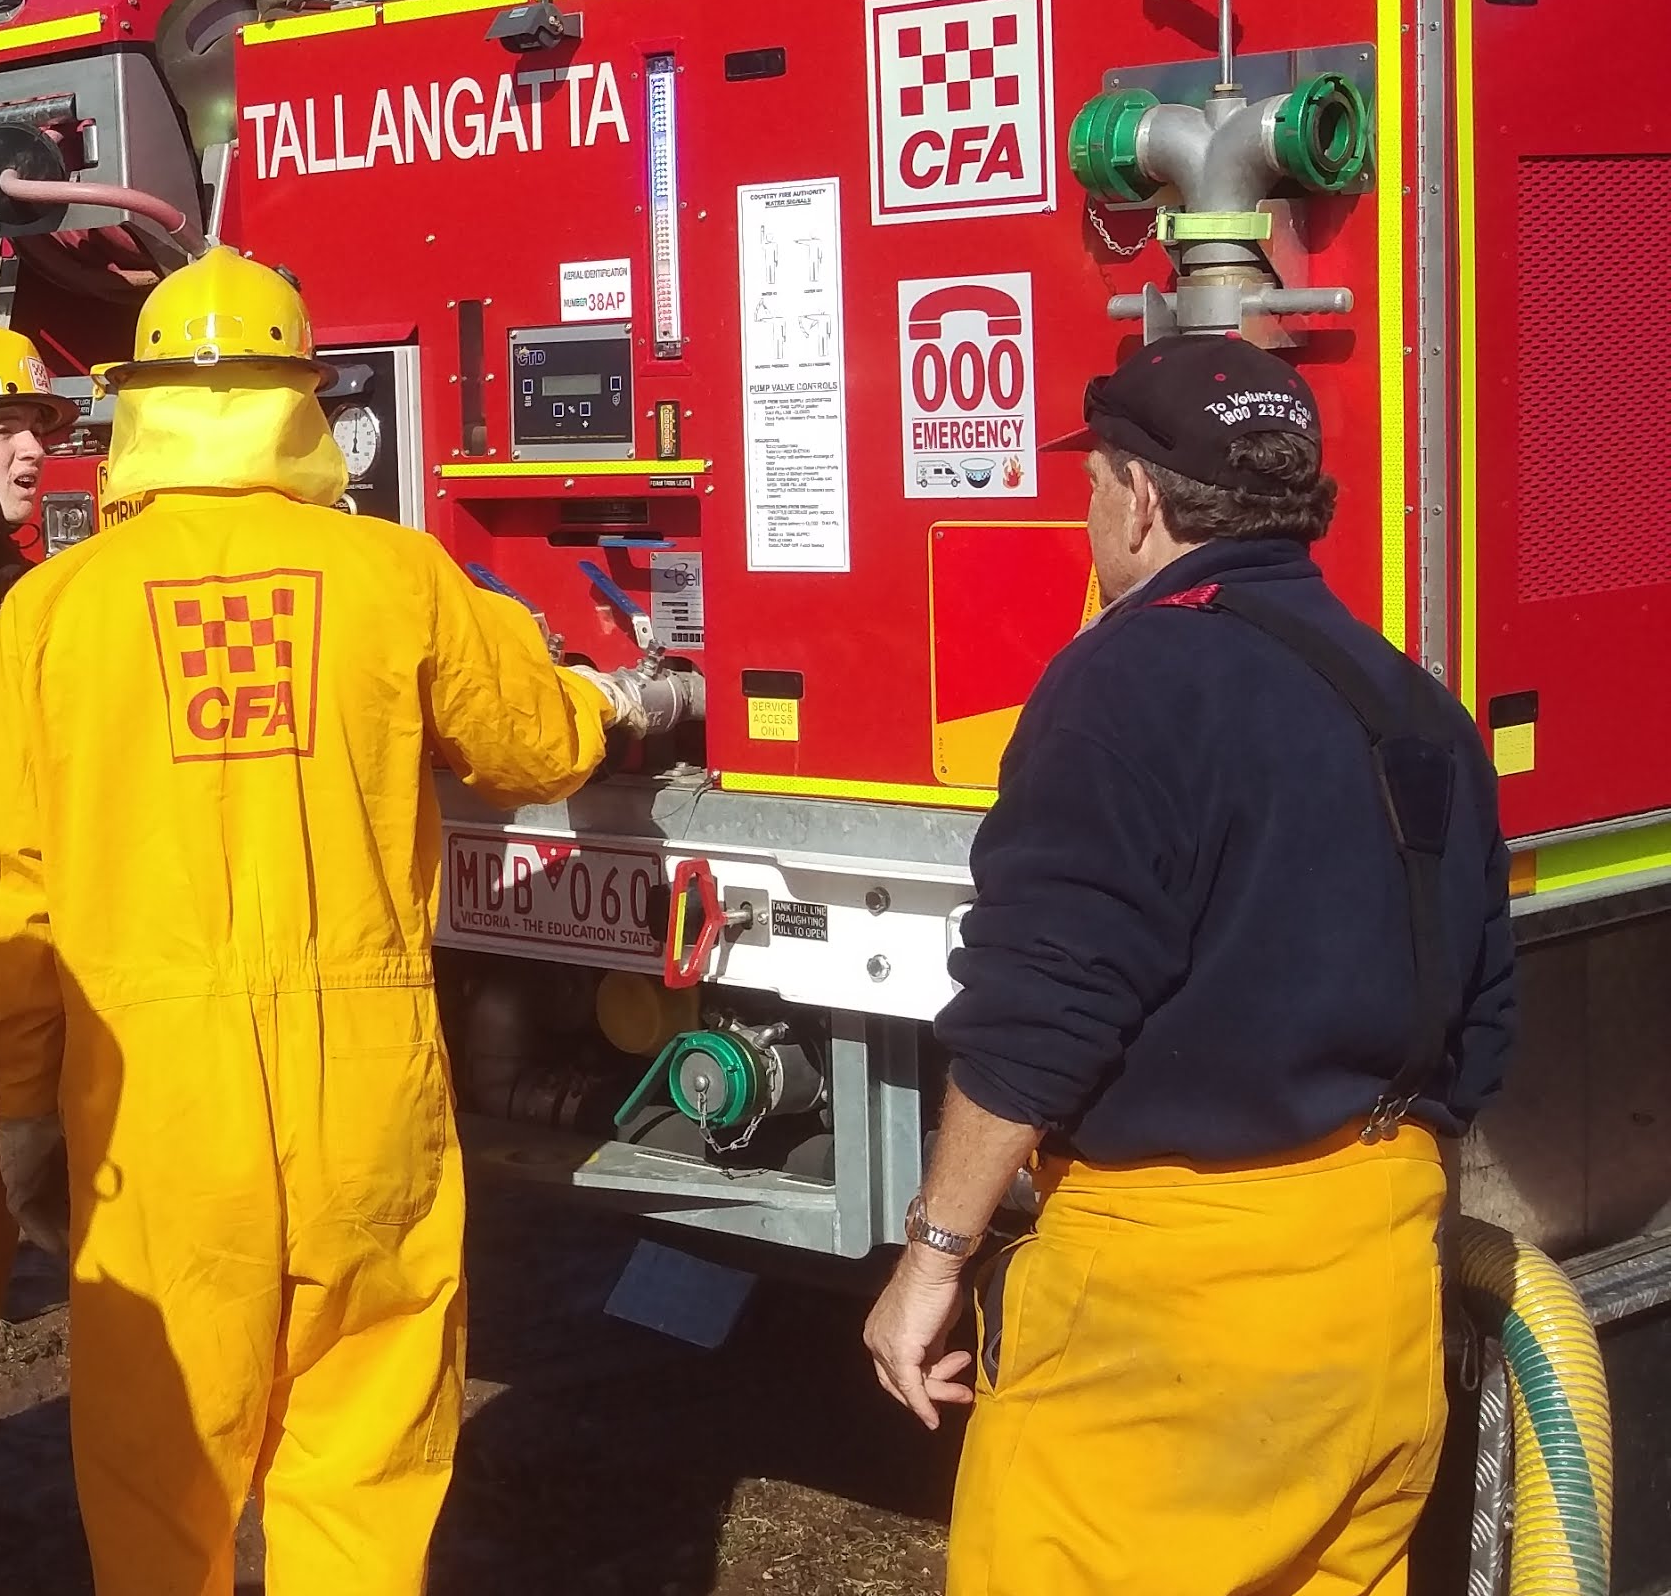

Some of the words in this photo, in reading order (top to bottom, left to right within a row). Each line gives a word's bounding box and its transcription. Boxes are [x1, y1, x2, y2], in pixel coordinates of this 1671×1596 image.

[243, 61, 630, 180] TALLANGATTA
[899, 122, 1025, 189] CFA
[563, 271, 583, 281] AERIAL
[588, 291, 626, 311] 38AP
[912, 340, 1024, 411] 000
[750, 384, 770, 393] PUMP
[771, 383, 795, 392] VALVE
[796, 381, 838, 391] CONTROLS
[1204, 402, 1227, 415] To
[1226, 390, 1293, 407] Volunteer
[1219, 405, 1252, 425] 1800
[1257, 403, 1286, 418] 232
[1288, 409, 1308, 430] 636
[912, 419, 1024, 451] EMERGENCY
[674, 568, 700, 587] bell
[186, 681, 296, 740] CFA
[752, 701, 792, 713] SERVICE
[753, 714, 793, 725] ACCESS
[761, 726, 785, 736] ONLY
[456, 850, 533, 915] MDB
[570, 862, 650, 929] 060
[772, 902, 791, 912] TANK
[793, 904, 808, 915] FILL
[809, 906, 827, 916] LINE
[461, 910, 511, 930] VICTORIA
[523, 918, 544, 934] THE
[547, 921, 616, 942] EDUCATION
[620, 930, 653, 947] STATE
[775, 913, 825, 927] DRAUGHTING
[773, 924, 792, 935] PULL
[794, 926, 804, 937] TO
[805, 927, 827, 939] OPEN
